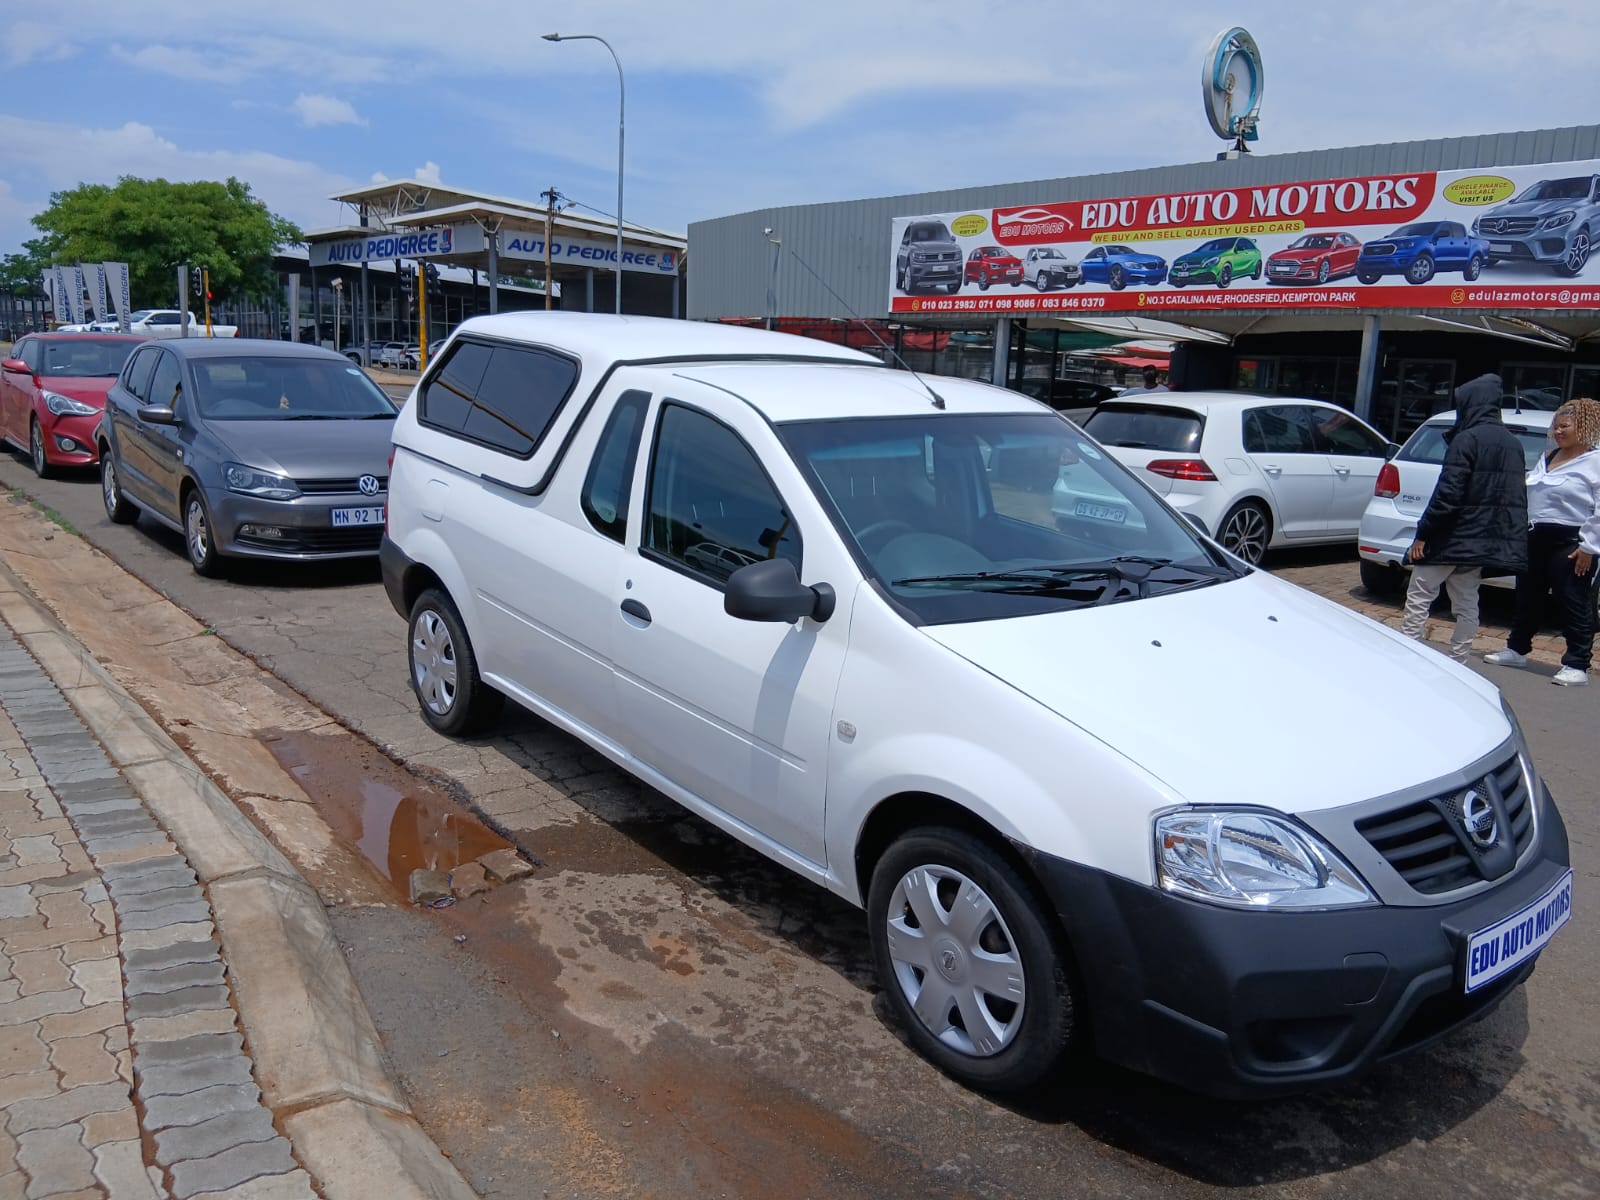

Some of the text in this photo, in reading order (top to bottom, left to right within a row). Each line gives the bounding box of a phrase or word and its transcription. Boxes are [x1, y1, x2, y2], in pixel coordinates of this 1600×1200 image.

[1081, 177, 1419, 230] EDU AUTO MOTORS
[1000, 221, 1065, 237] EDU MOTORS
[1094, 222, 1301, 243] WE BUY AND SELL QUALITY USED CARS
[328, 232, 439, 262] AUTO PEDIGREE
[507, 238, 657, 266] AUTO PEDIGREE
[922, 301, 936, 310] 010
[938, 300, 952, 310] 023
[978, 300, 993, 309] 071
[996, 299, 1011, 309] 098
[1013, 299, 1035, 309] 9086
[1042, 298, 1058, 308] 083
[1062, 298, 1078, 308] 846
[1081, 298, 1105, 307] 0370
[1146, 296, 1165, 305] NO.3
[1165, 295, 1205, 305] CATALINA
[1329, 292, 1356, 302] PARK
[354, 509, 369, 523] 92
[1471, 884, 1570, 977] EDU AUTO MOTORS
